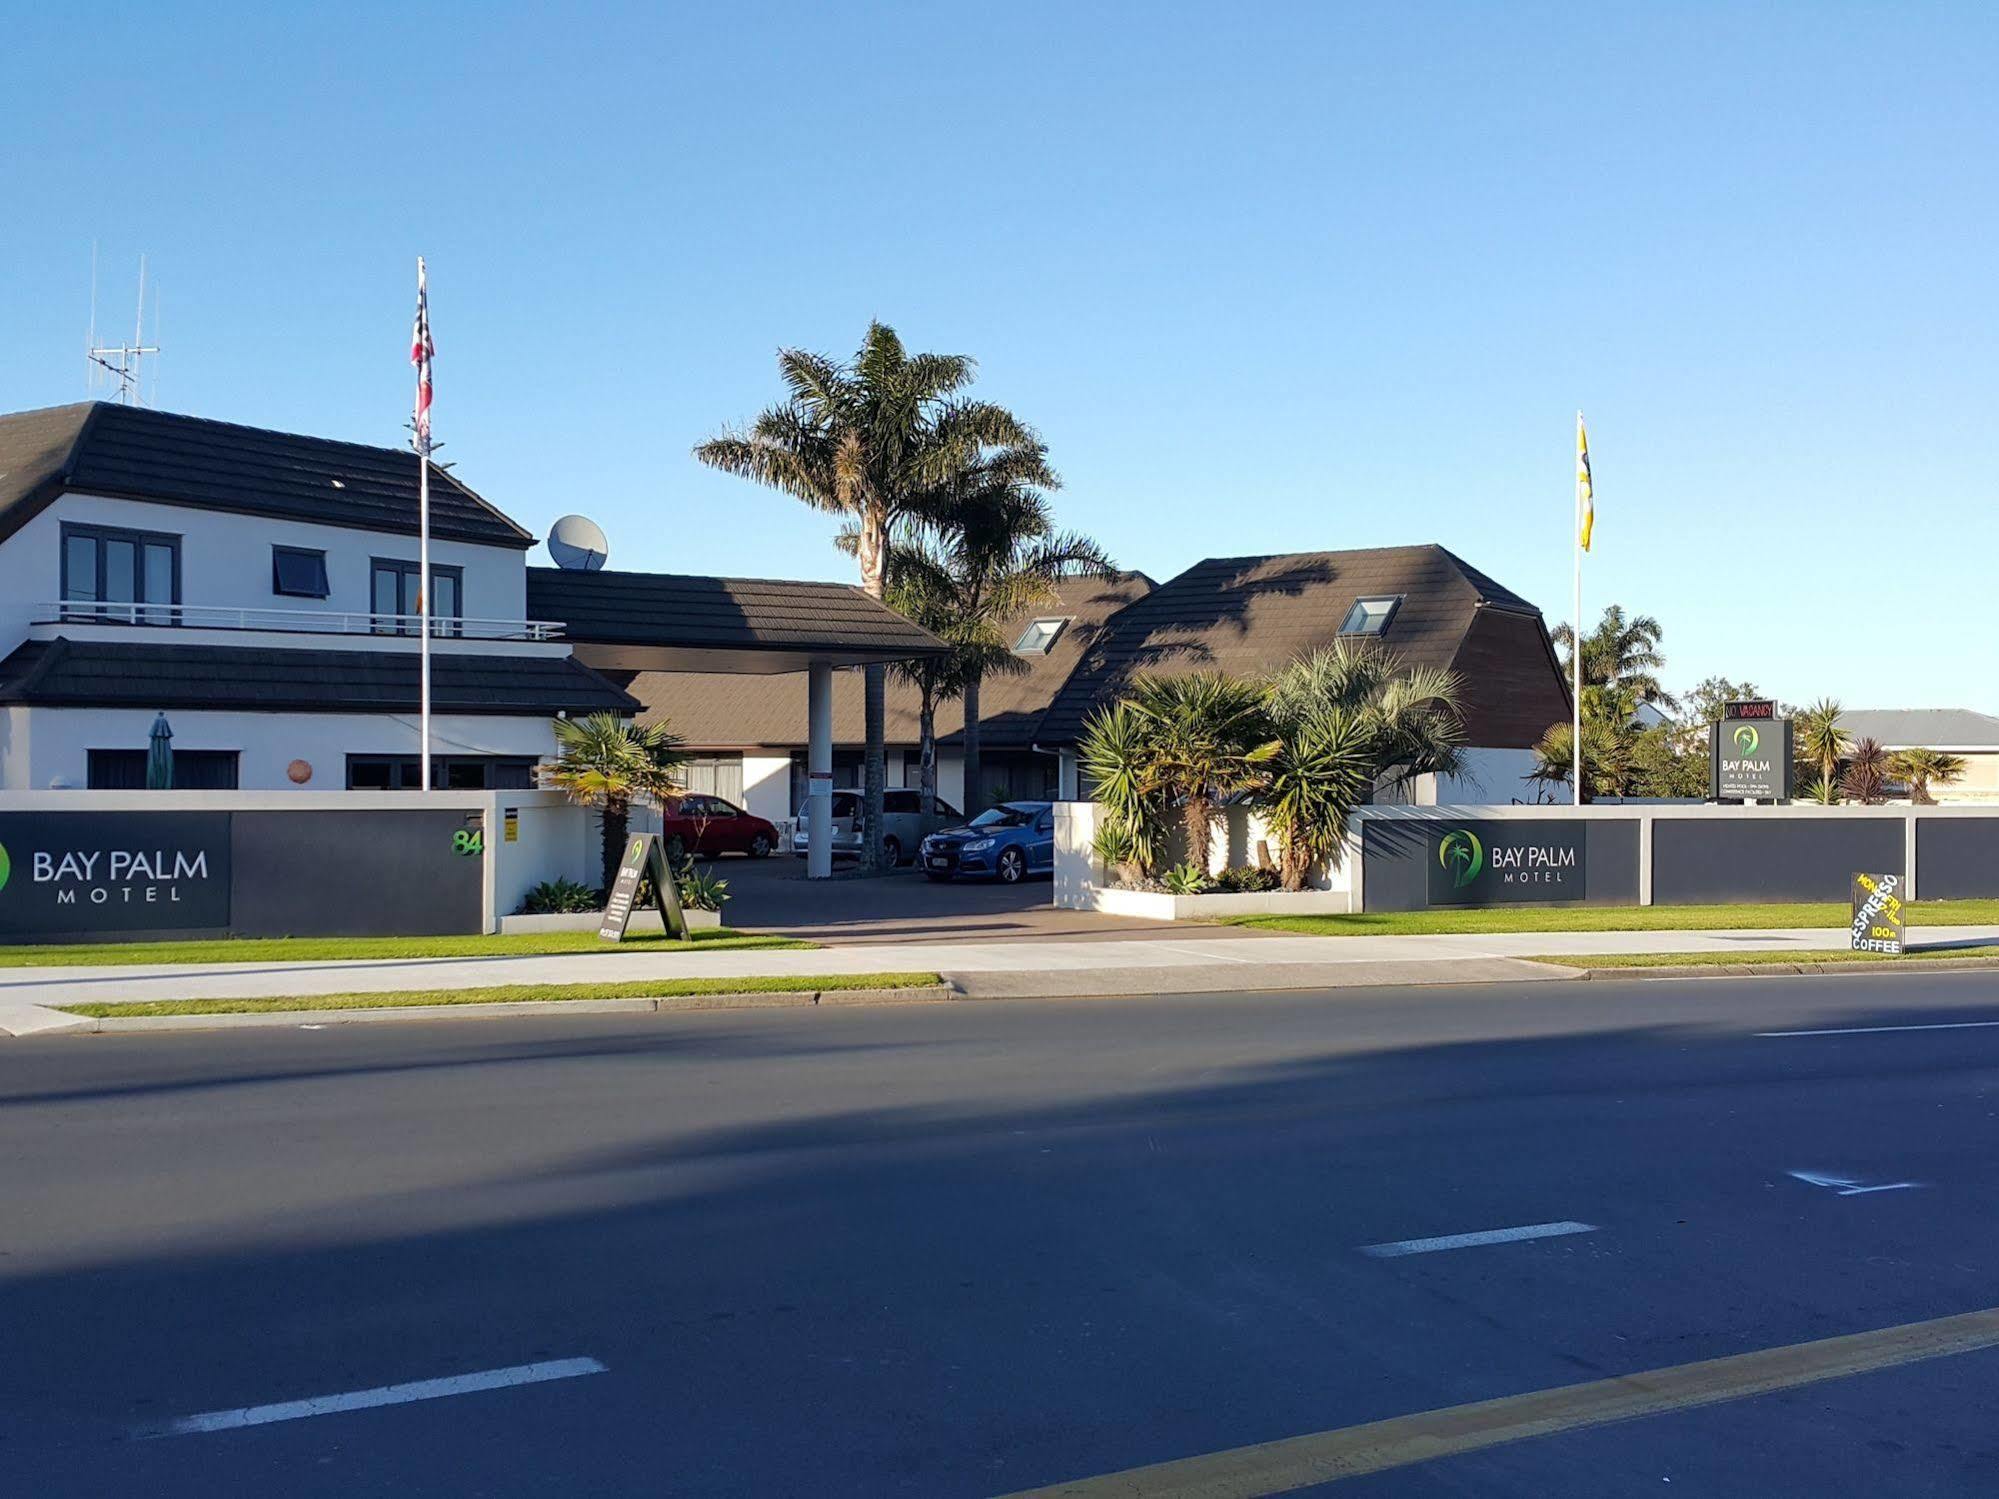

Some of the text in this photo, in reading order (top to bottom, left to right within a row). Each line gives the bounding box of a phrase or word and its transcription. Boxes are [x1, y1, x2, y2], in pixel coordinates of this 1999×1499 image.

[1726, 704, 1772, 718] NO VACANCY
[1723, 760, 1770, 771] BAY PALM
[453, 831, 484, 854] 84
[1492, 846, 1575, 868] BAY PALM
[33, 850, 208, 882] BAY PALM
[1504, 872, 1562, 883] MOTEL
[57, 887, 180, 903] MOTEL
[1852, 875, 1898, 940] ESPRESSO
[1853, 939, 1900, 953] COFFEE
